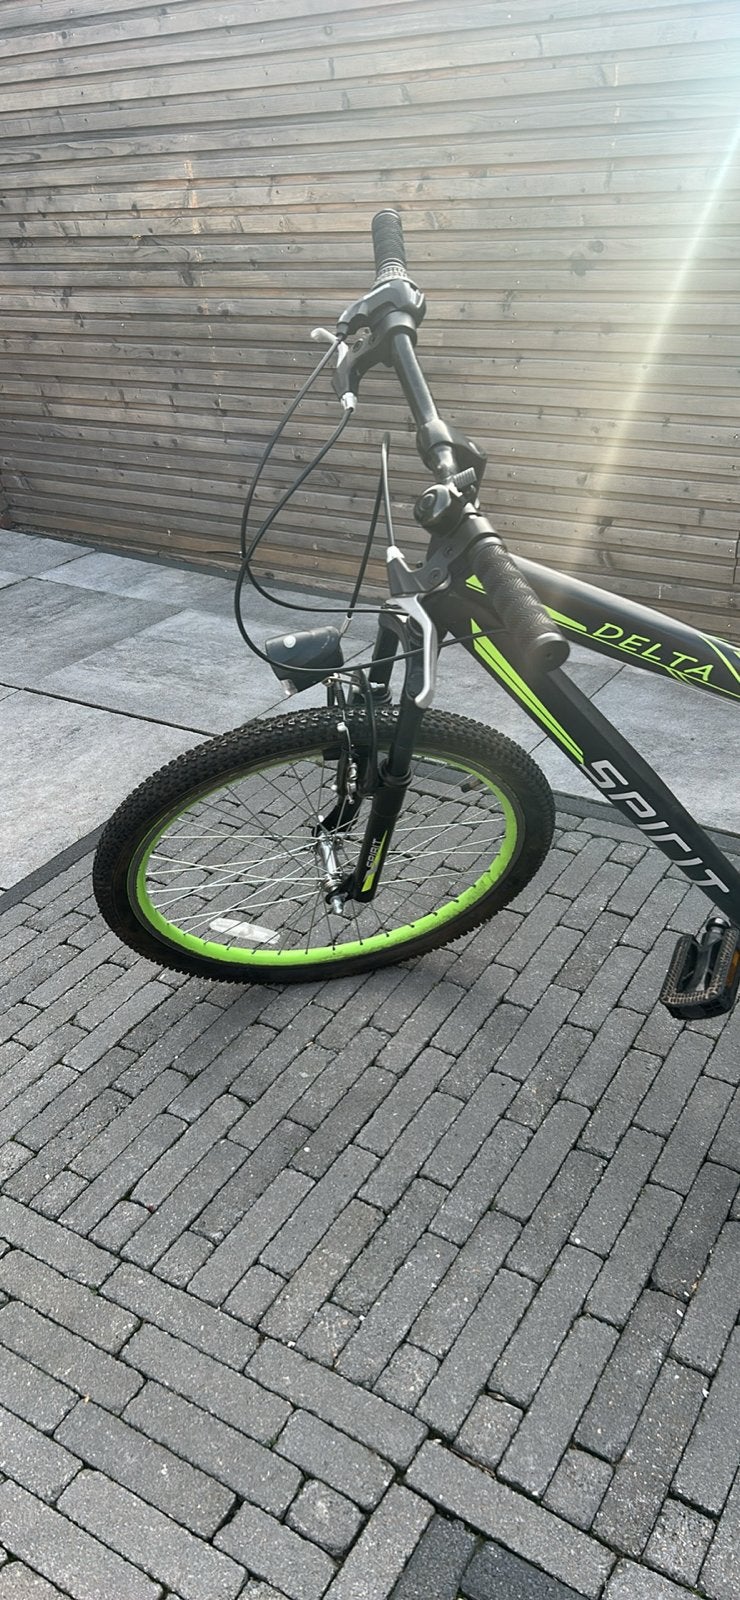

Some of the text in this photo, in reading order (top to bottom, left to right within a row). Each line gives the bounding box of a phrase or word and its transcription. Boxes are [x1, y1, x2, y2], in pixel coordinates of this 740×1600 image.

[592, 622, 714, 681] DELTA
[366, 838, 382, 868] SPIRIT
[580, 759, 730, 894] SPIRIT
